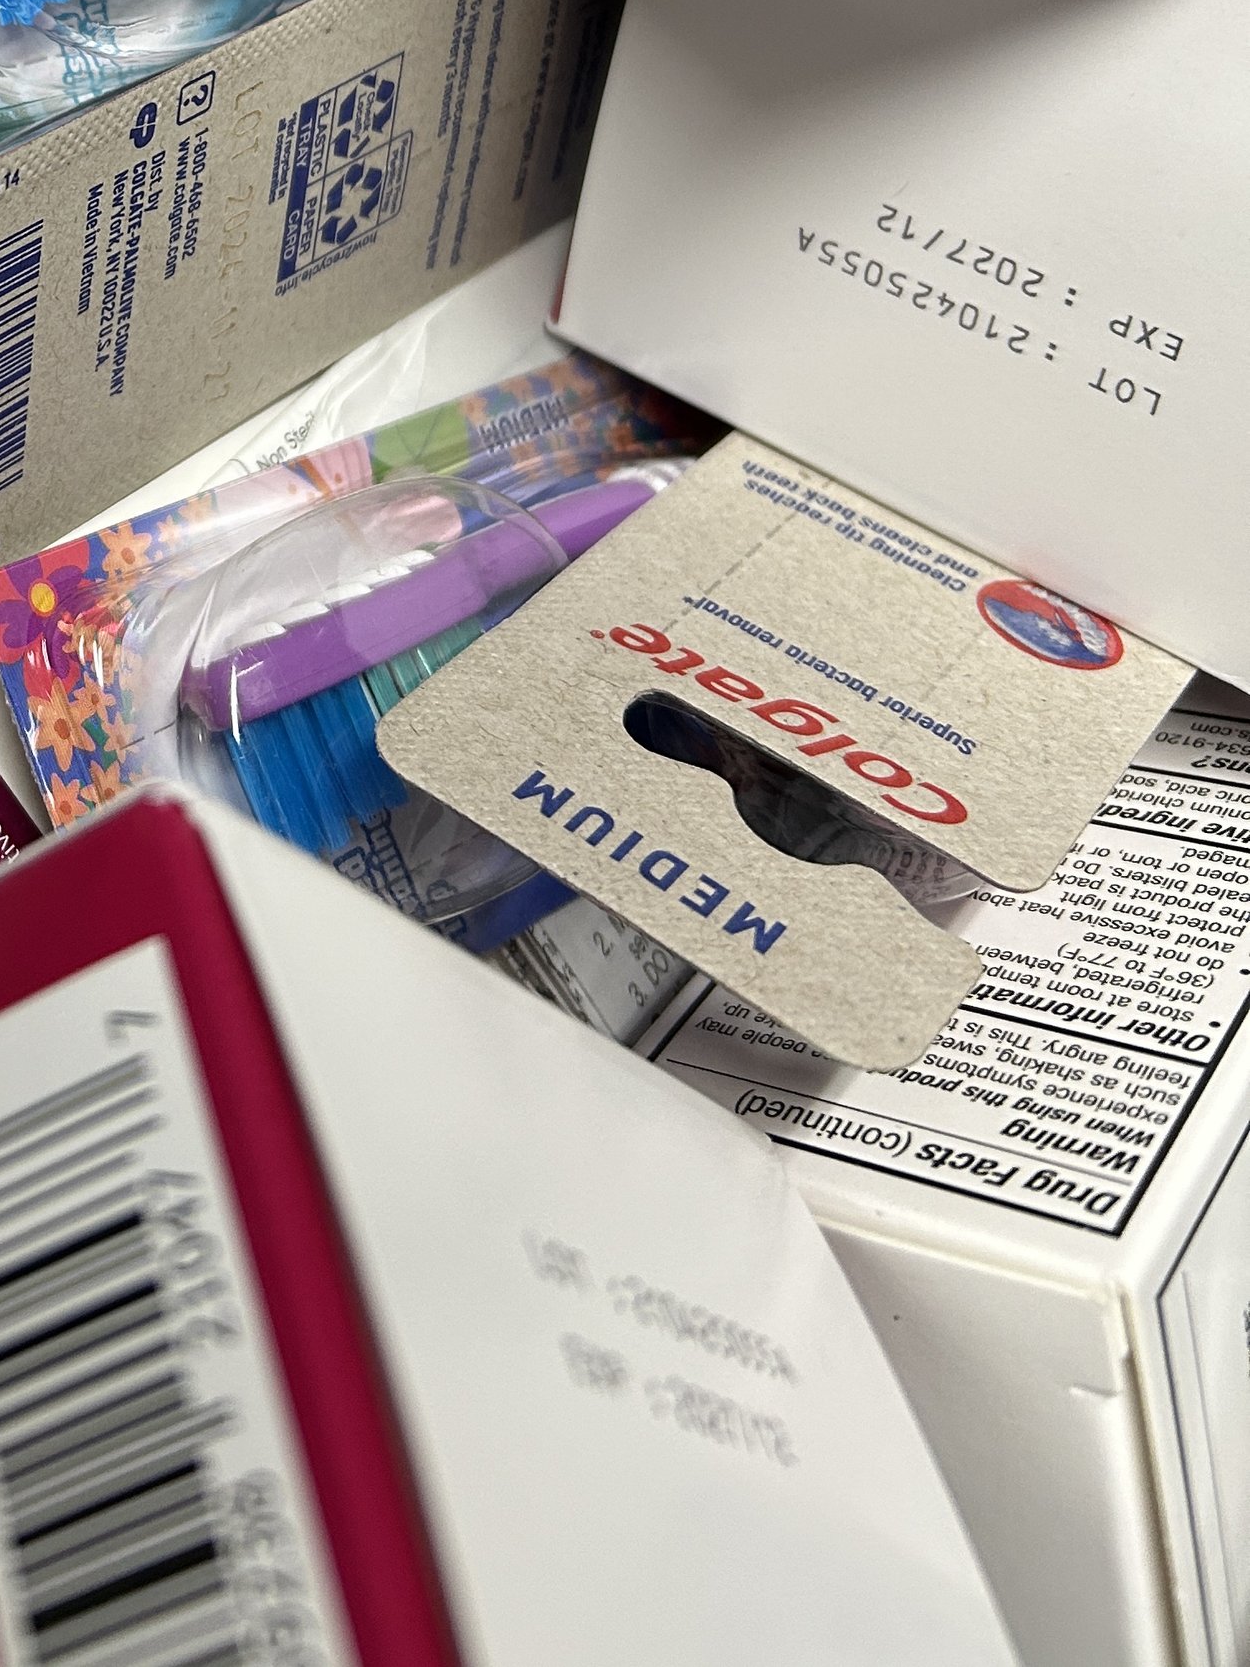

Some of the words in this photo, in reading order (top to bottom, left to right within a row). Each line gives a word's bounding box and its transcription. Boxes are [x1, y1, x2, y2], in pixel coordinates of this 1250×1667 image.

[294, 116, 313, 167] TRAY
[309, 97, 331, 177] PLASTIC
[111, 168, 129, 208] New
[147, 149, 166, 192] Dist.
[84, 181, 104, 231] Made
[143, 188, 163, 212] by
[163, 135, 191, 280] www.colgate.com
[180, 126, 209, 261] 1-800-468-6502
[83, 227, 101, 249] in
[105, 205, 126, 253] York,
[116, 159, 148, 325] COLGATE-PALMOLIVE
[281, 208, 301, 260] CARD
[295, 195, 318, 261] PAPER
[76, 244, 98, 315] Vietnam
[104, 249, 122, 275] NY
[274, 229, 377, 299] how2recycle.info
[98, 273, 119, 326] 10022
[94, 322, 113, 372] U.S.A.
[108, 322, 130, 397] COMPANY
[783, 643, 879, 702] bacteria
[608, 622, 968, 825] Colgate
[877, 695, 981, 756] Superior
[510, 762, 787, 955] MEDIUM
[974, 944, 1065, 976] between
[1081, 931, 1149, 956] freeze
[1152, 945, 1191, 963] not
[1195, 955, 1224, 971] do
[1071, 963, 1205, 1005] refrigerated,
[1123, 958, 1146, 974] to
[1045, 979, 1103, 1001] room
[1105, 993, 1132, 1007] at
[1136, 1000, 1194, 1022] store
[962, 1021, 984, 1038] is
[987, 1027, 1032, 1051] This
[1115, 1018, 1211, 1052] Other
[921, 1052, 1038, 1091] symptoms
[994, 1046, 1086, 1082] shaking,
[1041, 1038, 1108, 1066] angry.
[1111, 1055, 1191, 1090] feeling
[960, 1085, 1009, 1107] this
[1089, 1073, 1119, 1090] as
[1123, 1081, 1181, 1106] such
[734, 1088, 912, 1158] (continued)
[1010, 1096, 1081, 1125] using
[1041, 1083, 1169, 1125] experience
[999, 1118, 1141, 1174] Warning
[1083, 1117, 1155, 1148] When
[913, 1142, 1020, 1187] Facts
[1021, 1168, 1122, 1216] Drug
